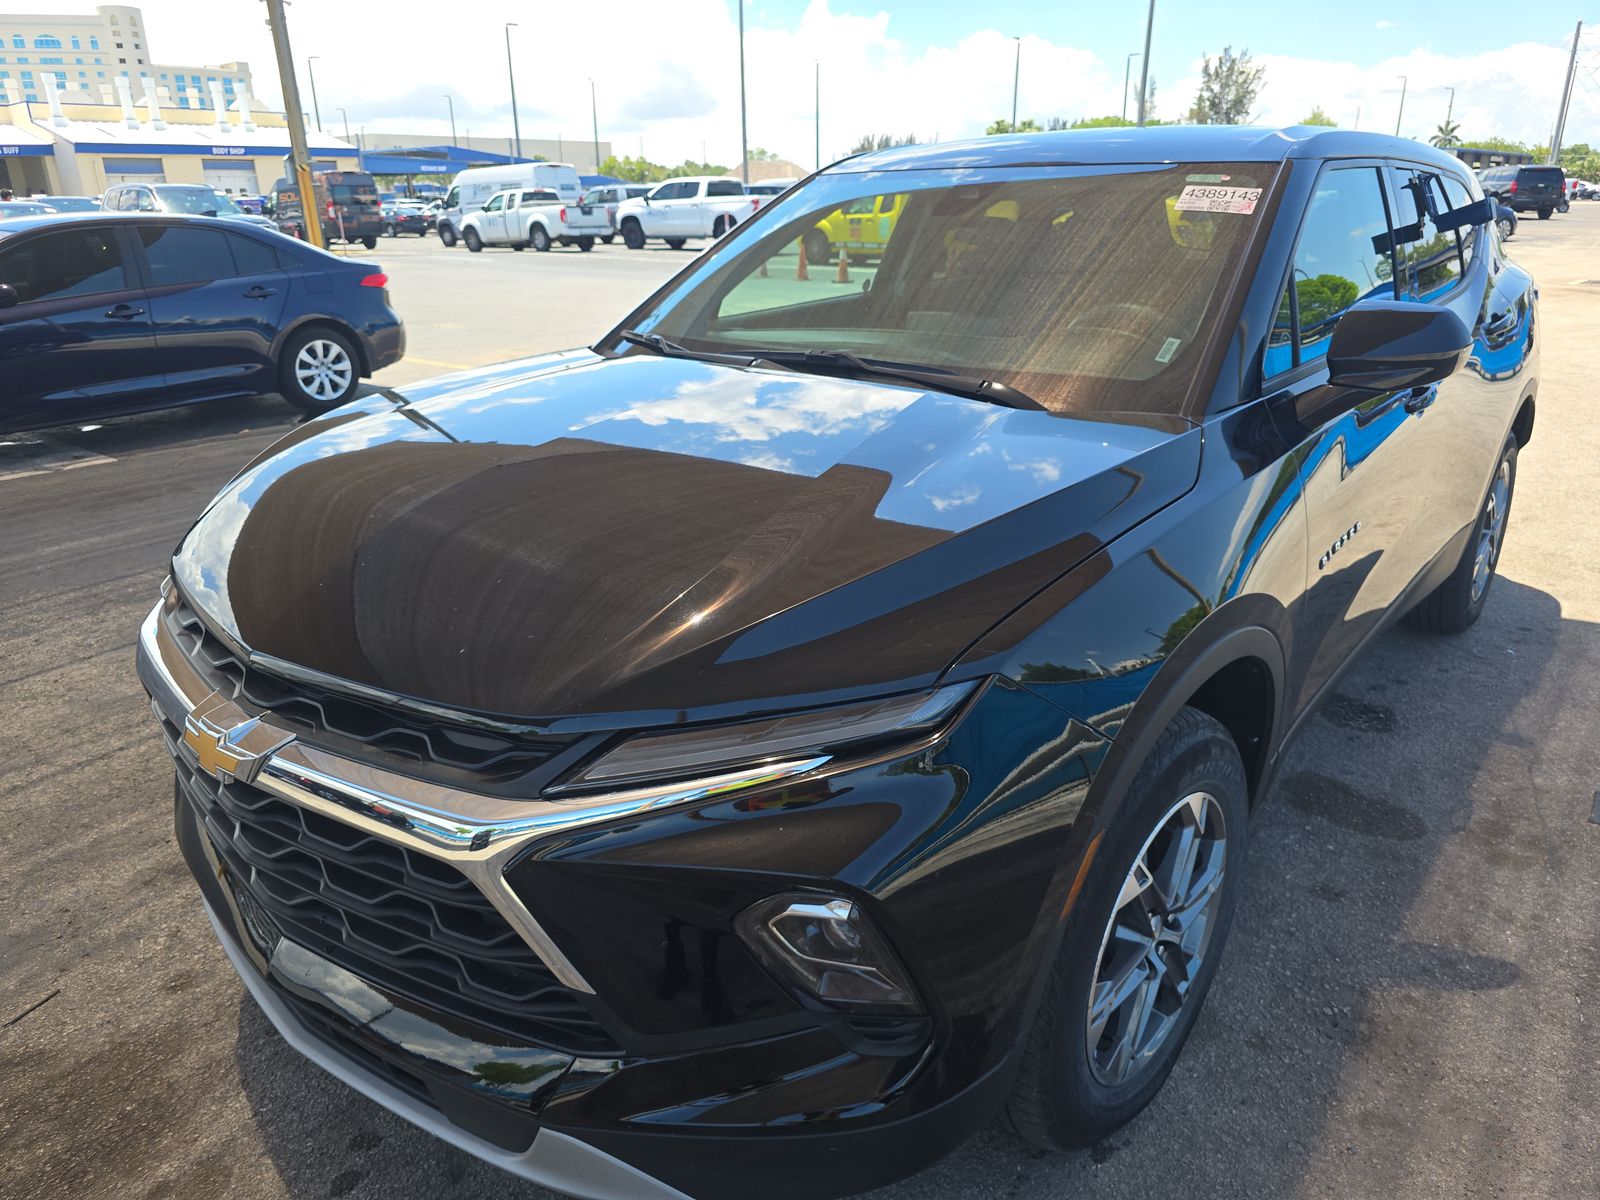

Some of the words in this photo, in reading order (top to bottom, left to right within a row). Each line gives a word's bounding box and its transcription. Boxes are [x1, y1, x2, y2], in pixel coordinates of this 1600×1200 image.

[3, 146, 19, 155] BUFF
[212, 146, 228, 155] BODY
[229, 147, 246, 155] SHOP
[1185, 189, 1260, 201] 4389143
